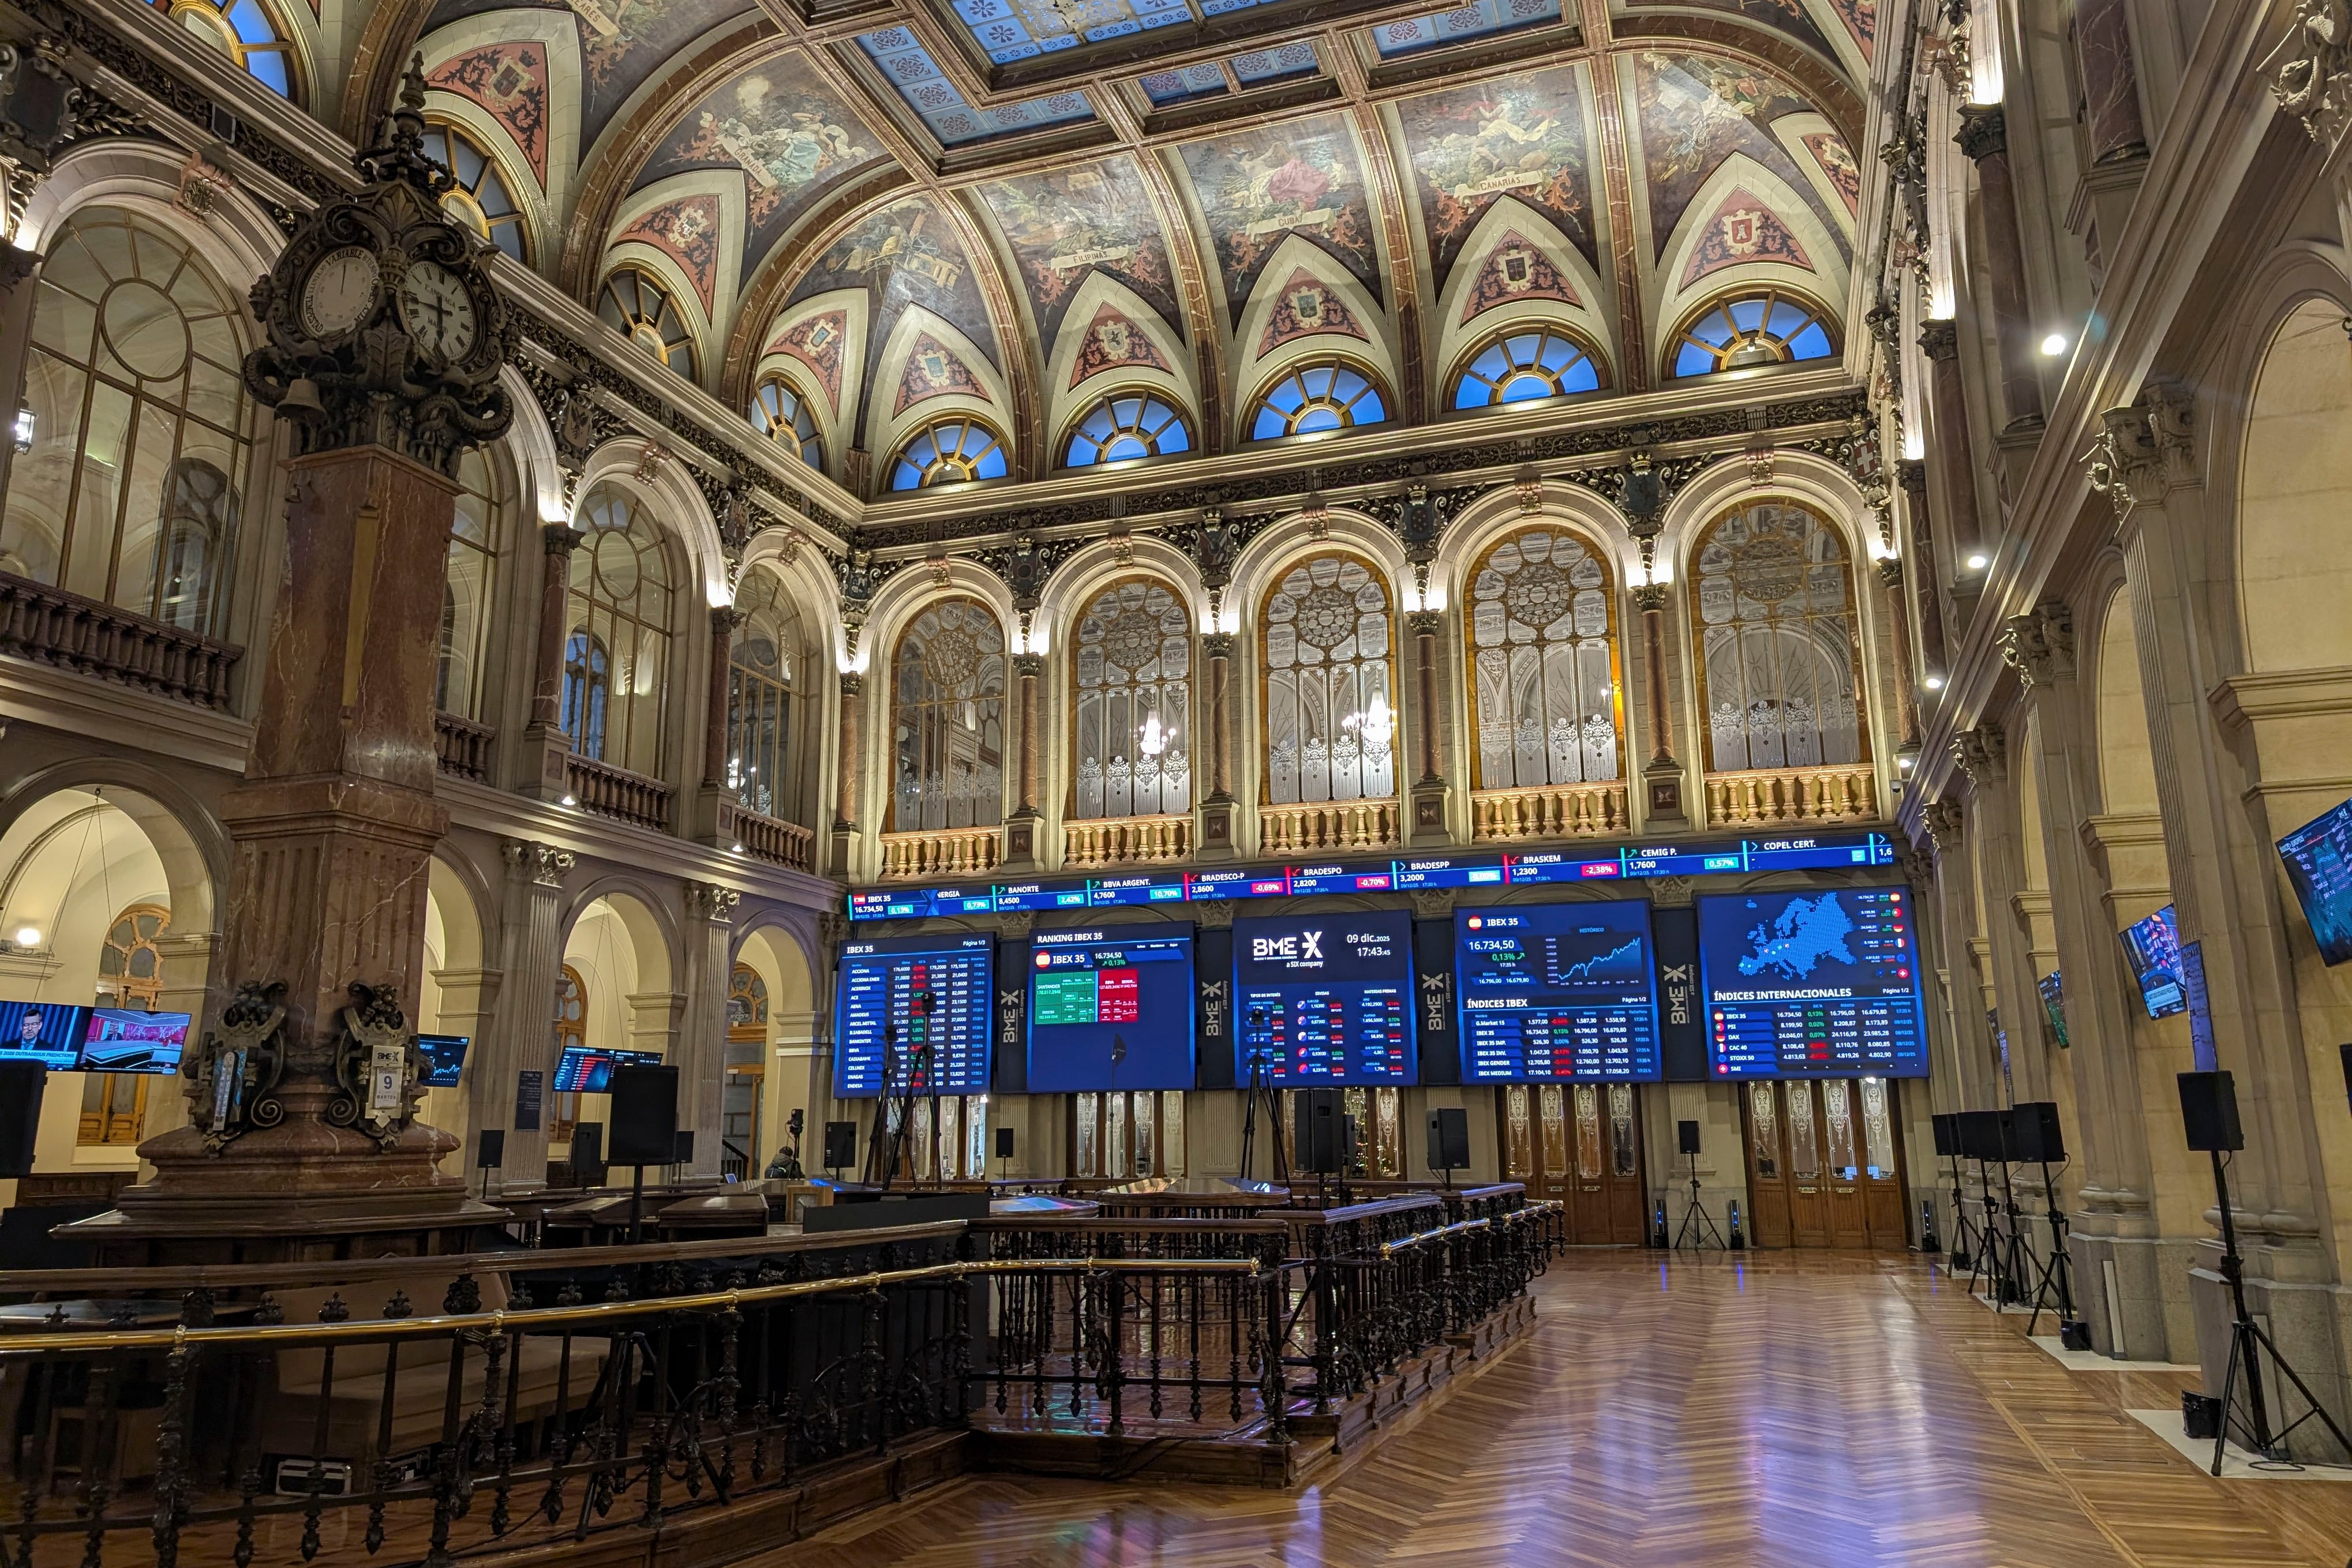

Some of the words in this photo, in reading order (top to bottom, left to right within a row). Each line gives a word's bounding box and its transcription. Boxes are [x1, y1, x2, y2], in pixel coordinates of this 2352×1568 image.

[734, 148, 762, 177] GRANADA.
[1480, 176, 1523, 190] CANARIAS.
[1278, 216, 1301, 227] CUBA
[1073, 252, 1110, 263] FILIPINAS.
[1764, 841, 1792, 850] COPEL
[1792, 840, 1817, 849] CERT.
[1641, 849, 1669, 857] CEMIG
[1670, 848, 1677, 856] P.
[1523, 854, 1561, 864] BRASKEM
[1630, 860, 1656, 869] 1,7600
[1708, 859, 1735, 868] 0,57%
[1411, 861, 1450, 871] BRADESPP
[1304, 867, 1342, 876] BRADESPO
[1512, 868, 1538, 876] 1,2300
[1201, 873, 1245, 882] BRADESCO-P
[1294, 880, 1317, 888] 2,8200
[1360, 877, 1385, 886] -0,70%
[1400, 874, 1425, 882] 3,2000
[1122, 879, 1151, 887] ARGENT.
[1008, 885, 1039, 894] BANORTE
[1192, 886, 1214, 894] 2,8600
[1256, 883, 1279, 892] -0,69%
[1094, 891, 1115, 899] 4,7600
[855, 905, 883, 913] 16.734,50
[1487, 918, 1507, 926] IBEX
[1508, 917, 1518, 925] 35
[1038, 934, 1073, 943] RANKING
[1074, 933, 1092, 941] IBEX
[1093, 932, 1103, 940] 35
[1347, 935, 1358, 943] 09
[1253, 937, 1297, 956] BME
[1469, 940, 1514, 950] 16.734,50
[1053, 955, 1073, 964] IBEX
[1074, 954, 1085, 963] 35
[1492, 952, 1515, 961] 0,13%
[1714, 991, 1754, 1001] ÍNDICES
[1756, 988, 1852, 1000] INTERNACIONALES
[1467, 999, 1504, 1008] ÍNDICES
[1506, 998, 1527, 1007] IBEX
[1668, 986, 1686, 1024] BME
[1426, 993, 1442, 1030] BME
[1205, 1001, 1219, 1036] BME
[1003, 1008, 1016, 1043] BME
[384, 1075, 392, 1090] 9
